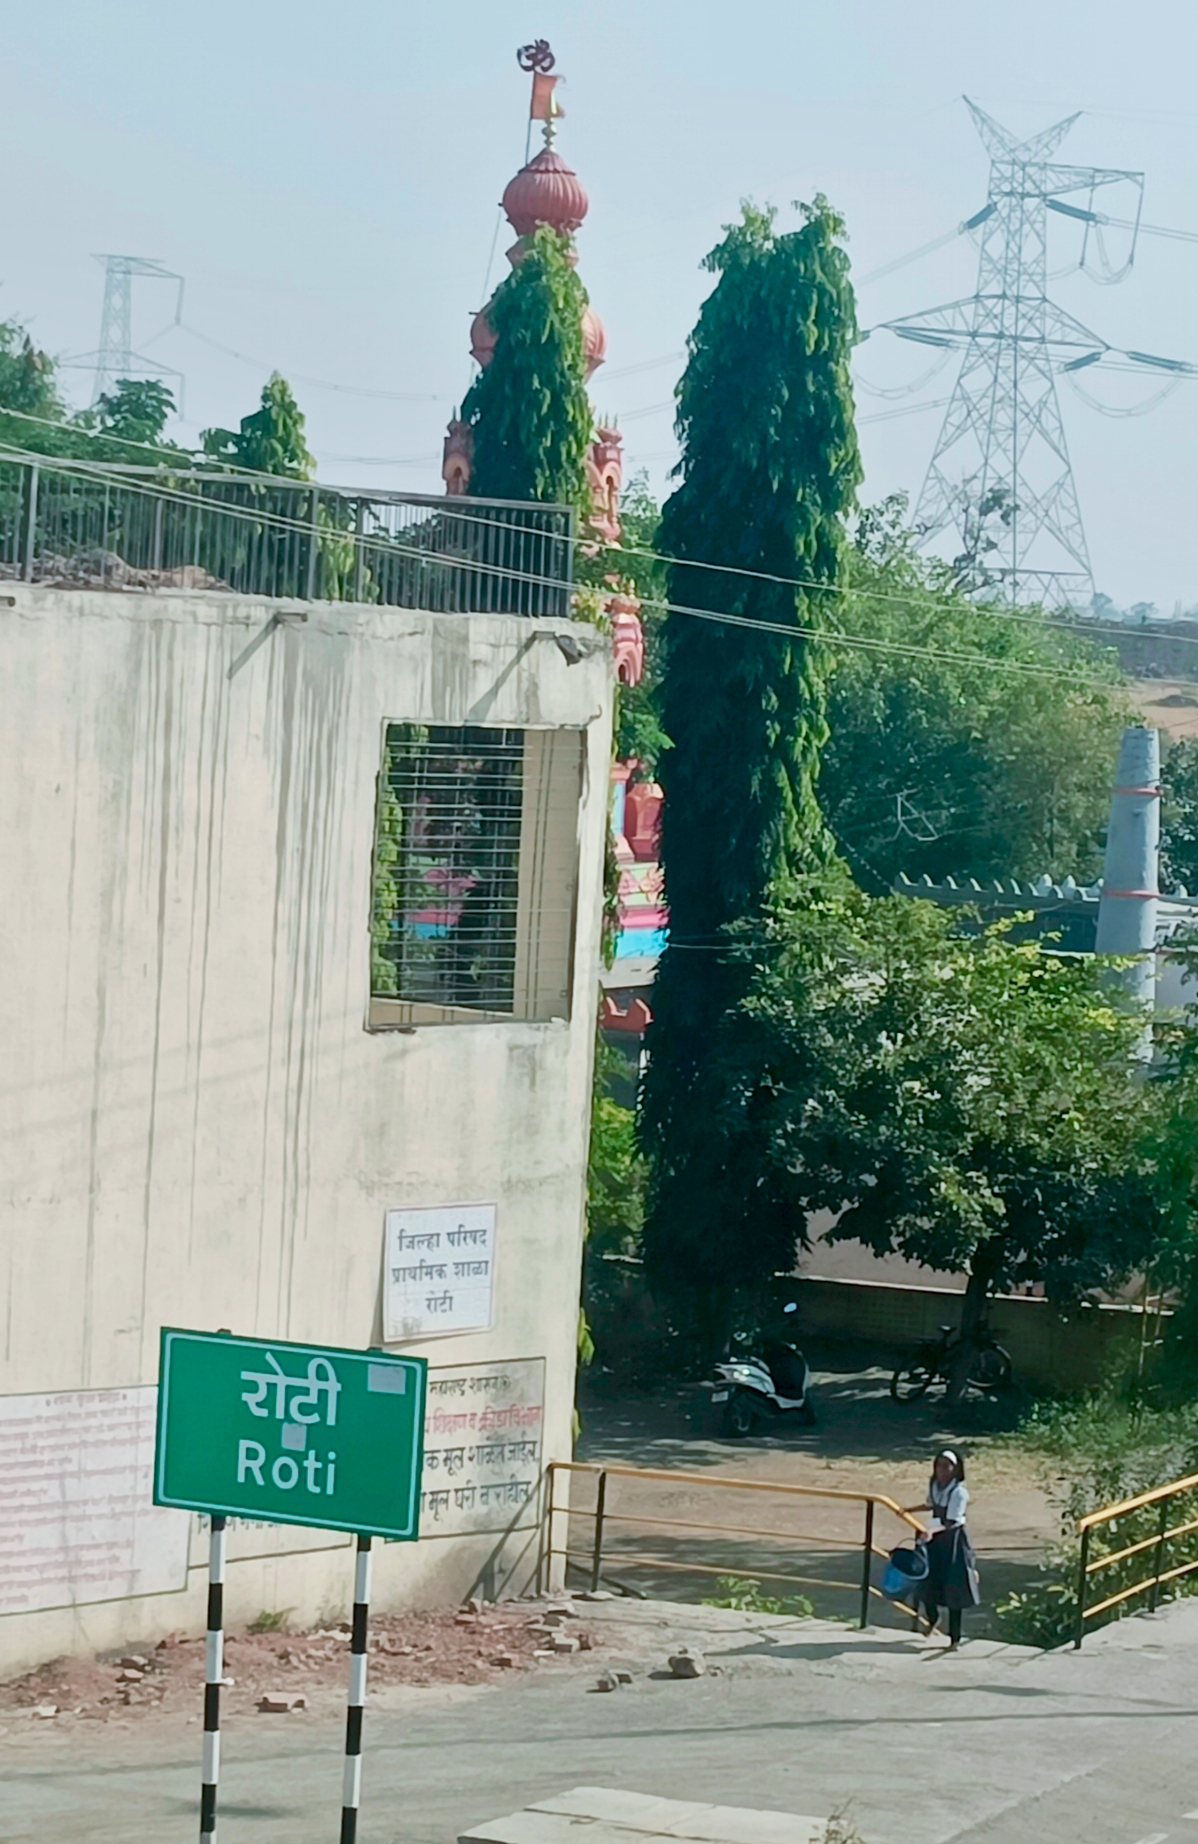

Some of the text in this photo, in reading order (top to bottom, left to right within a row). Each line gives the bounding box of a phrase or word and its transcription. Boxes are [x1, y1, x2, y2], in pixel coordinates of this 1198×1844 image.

[397, 1228, 441, 1252] जिल्हा
[391, 1258, 490, 1284] प्राथमिक शाळा
[425, 1289, 454, 1314] रोटी
[240, 1351, 342, 1426] रोटी
[237, 1439, 337, 1495] Roti
